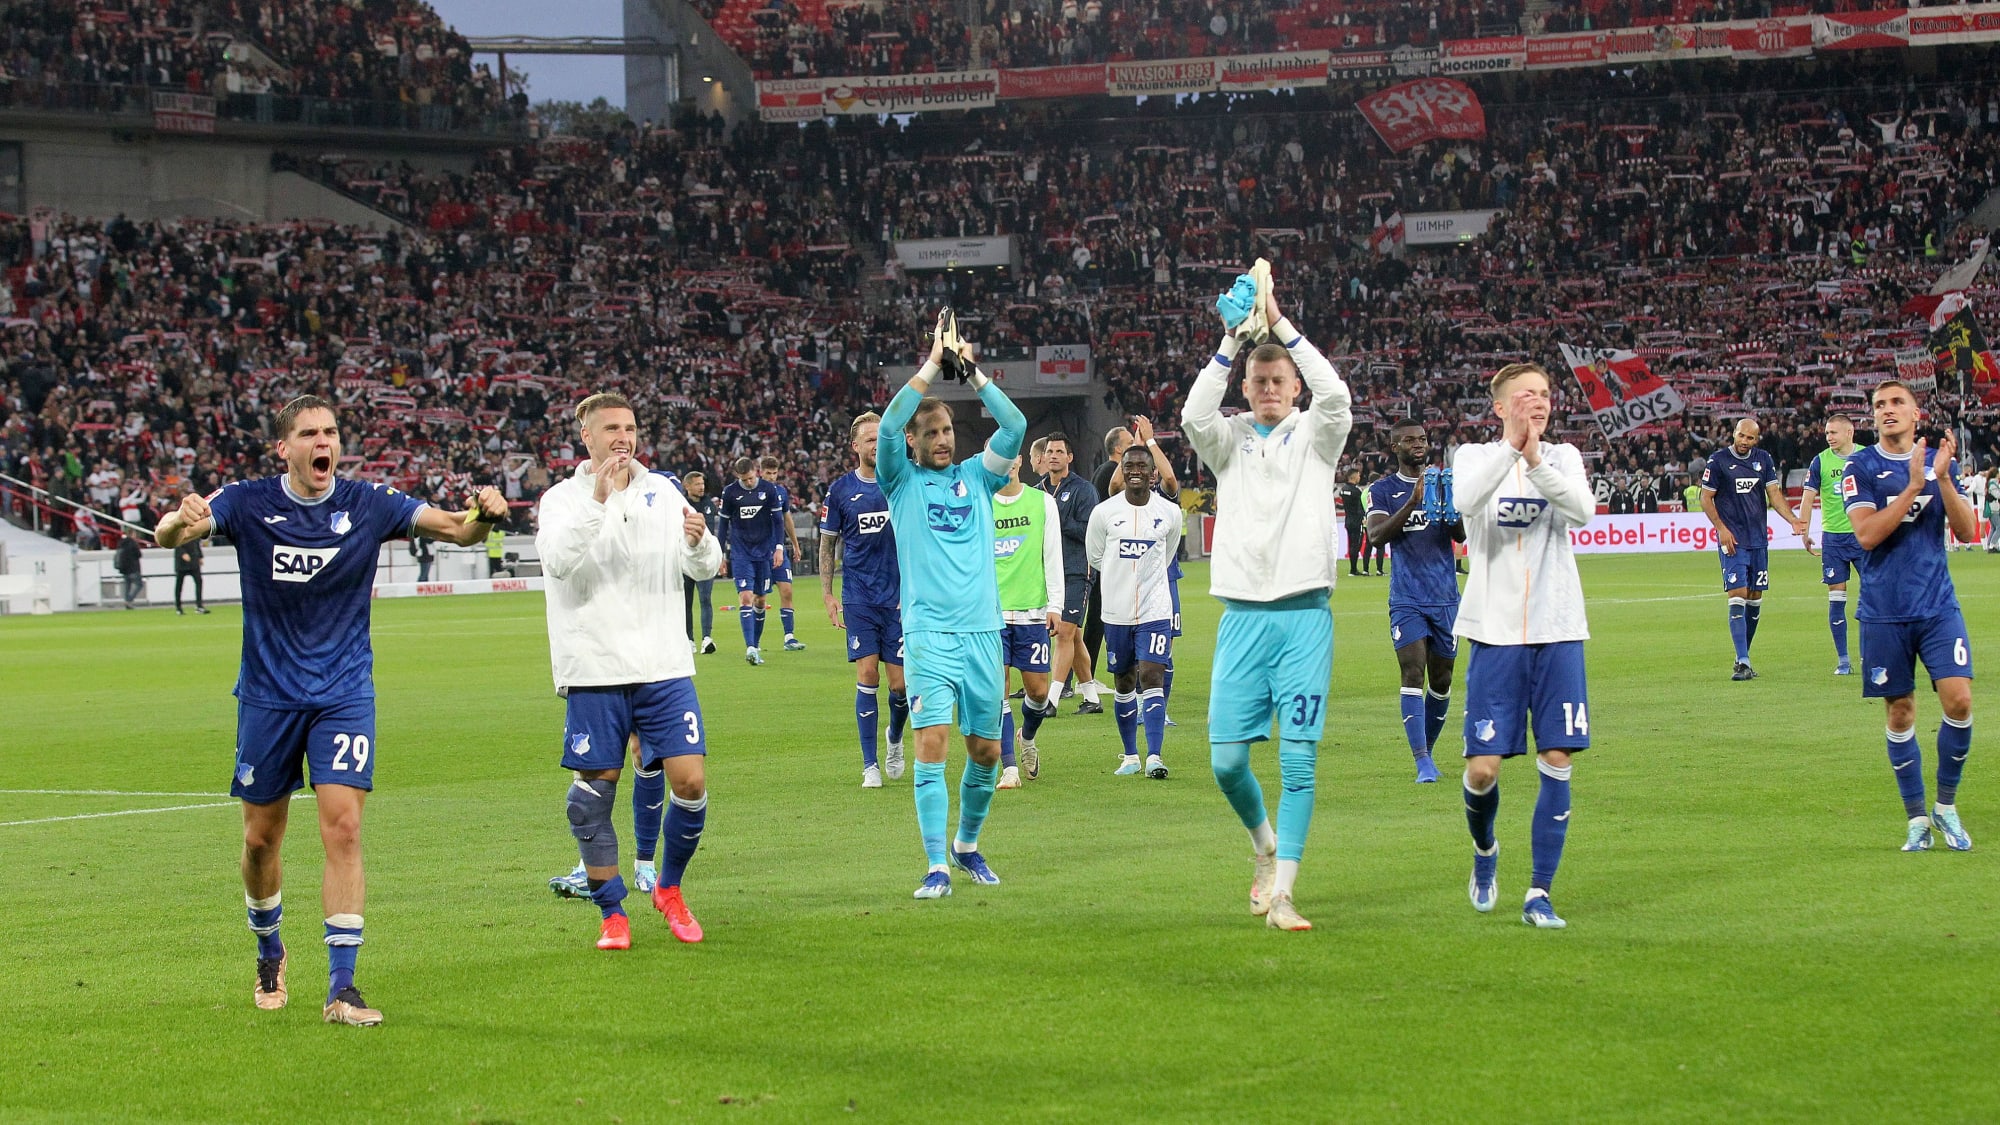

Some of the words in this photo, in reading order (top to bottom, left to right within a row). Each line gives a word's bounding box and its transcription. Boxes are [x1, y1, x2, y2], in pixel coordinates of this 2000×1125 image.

[1759, 32, 1784, 49] 0711
[1331, 55, 1382, 65] SCHWABEN
[1444, 58, 1511, 71] HOCHDORF
[863, 72, 991, 88] Stuttgarter
[1115, 64, 1176, 82] INVASION
[1180, 63, 1211, 80] 1893
[1117, 78, 1212, 91] STRAUBENHARDT
[863, 90, 914, 110] CVJM
[922, 86, 990, 104] Buaben
[1428, 219, 1454, 231] MHP
[996, 370, 1002, 379] 2
[1598, 392, 1672, 435] BWOYS
[1831, 469, 1842, 479] JO
[1736, 481, 1753, 490] SAP
[741, 508, 757, 517] SAP
[929, 508, 964, 528] SAP
[1498, 501, 1540, 523] SAP
[860, 516, 886, 530] SAP
[995, 515, 1031, 530] oma
[994, 539, 1020, 555] SAP
[1120, 541, 1148, 557] SAP
[275, 552, 324, 576] SAP
[1756, 570, 1768, 586] 23
[1149, 632, 1166, 656] 18
[1953, 637, 1968, 666] 6
[1030, 642, 1049, 665] 20
[1291, 694, 1322, 727] 37
[1562, 702, 1588, 736] 14
[683, 711, 699, 744] 3
[332, 733, 369, 773] 29
